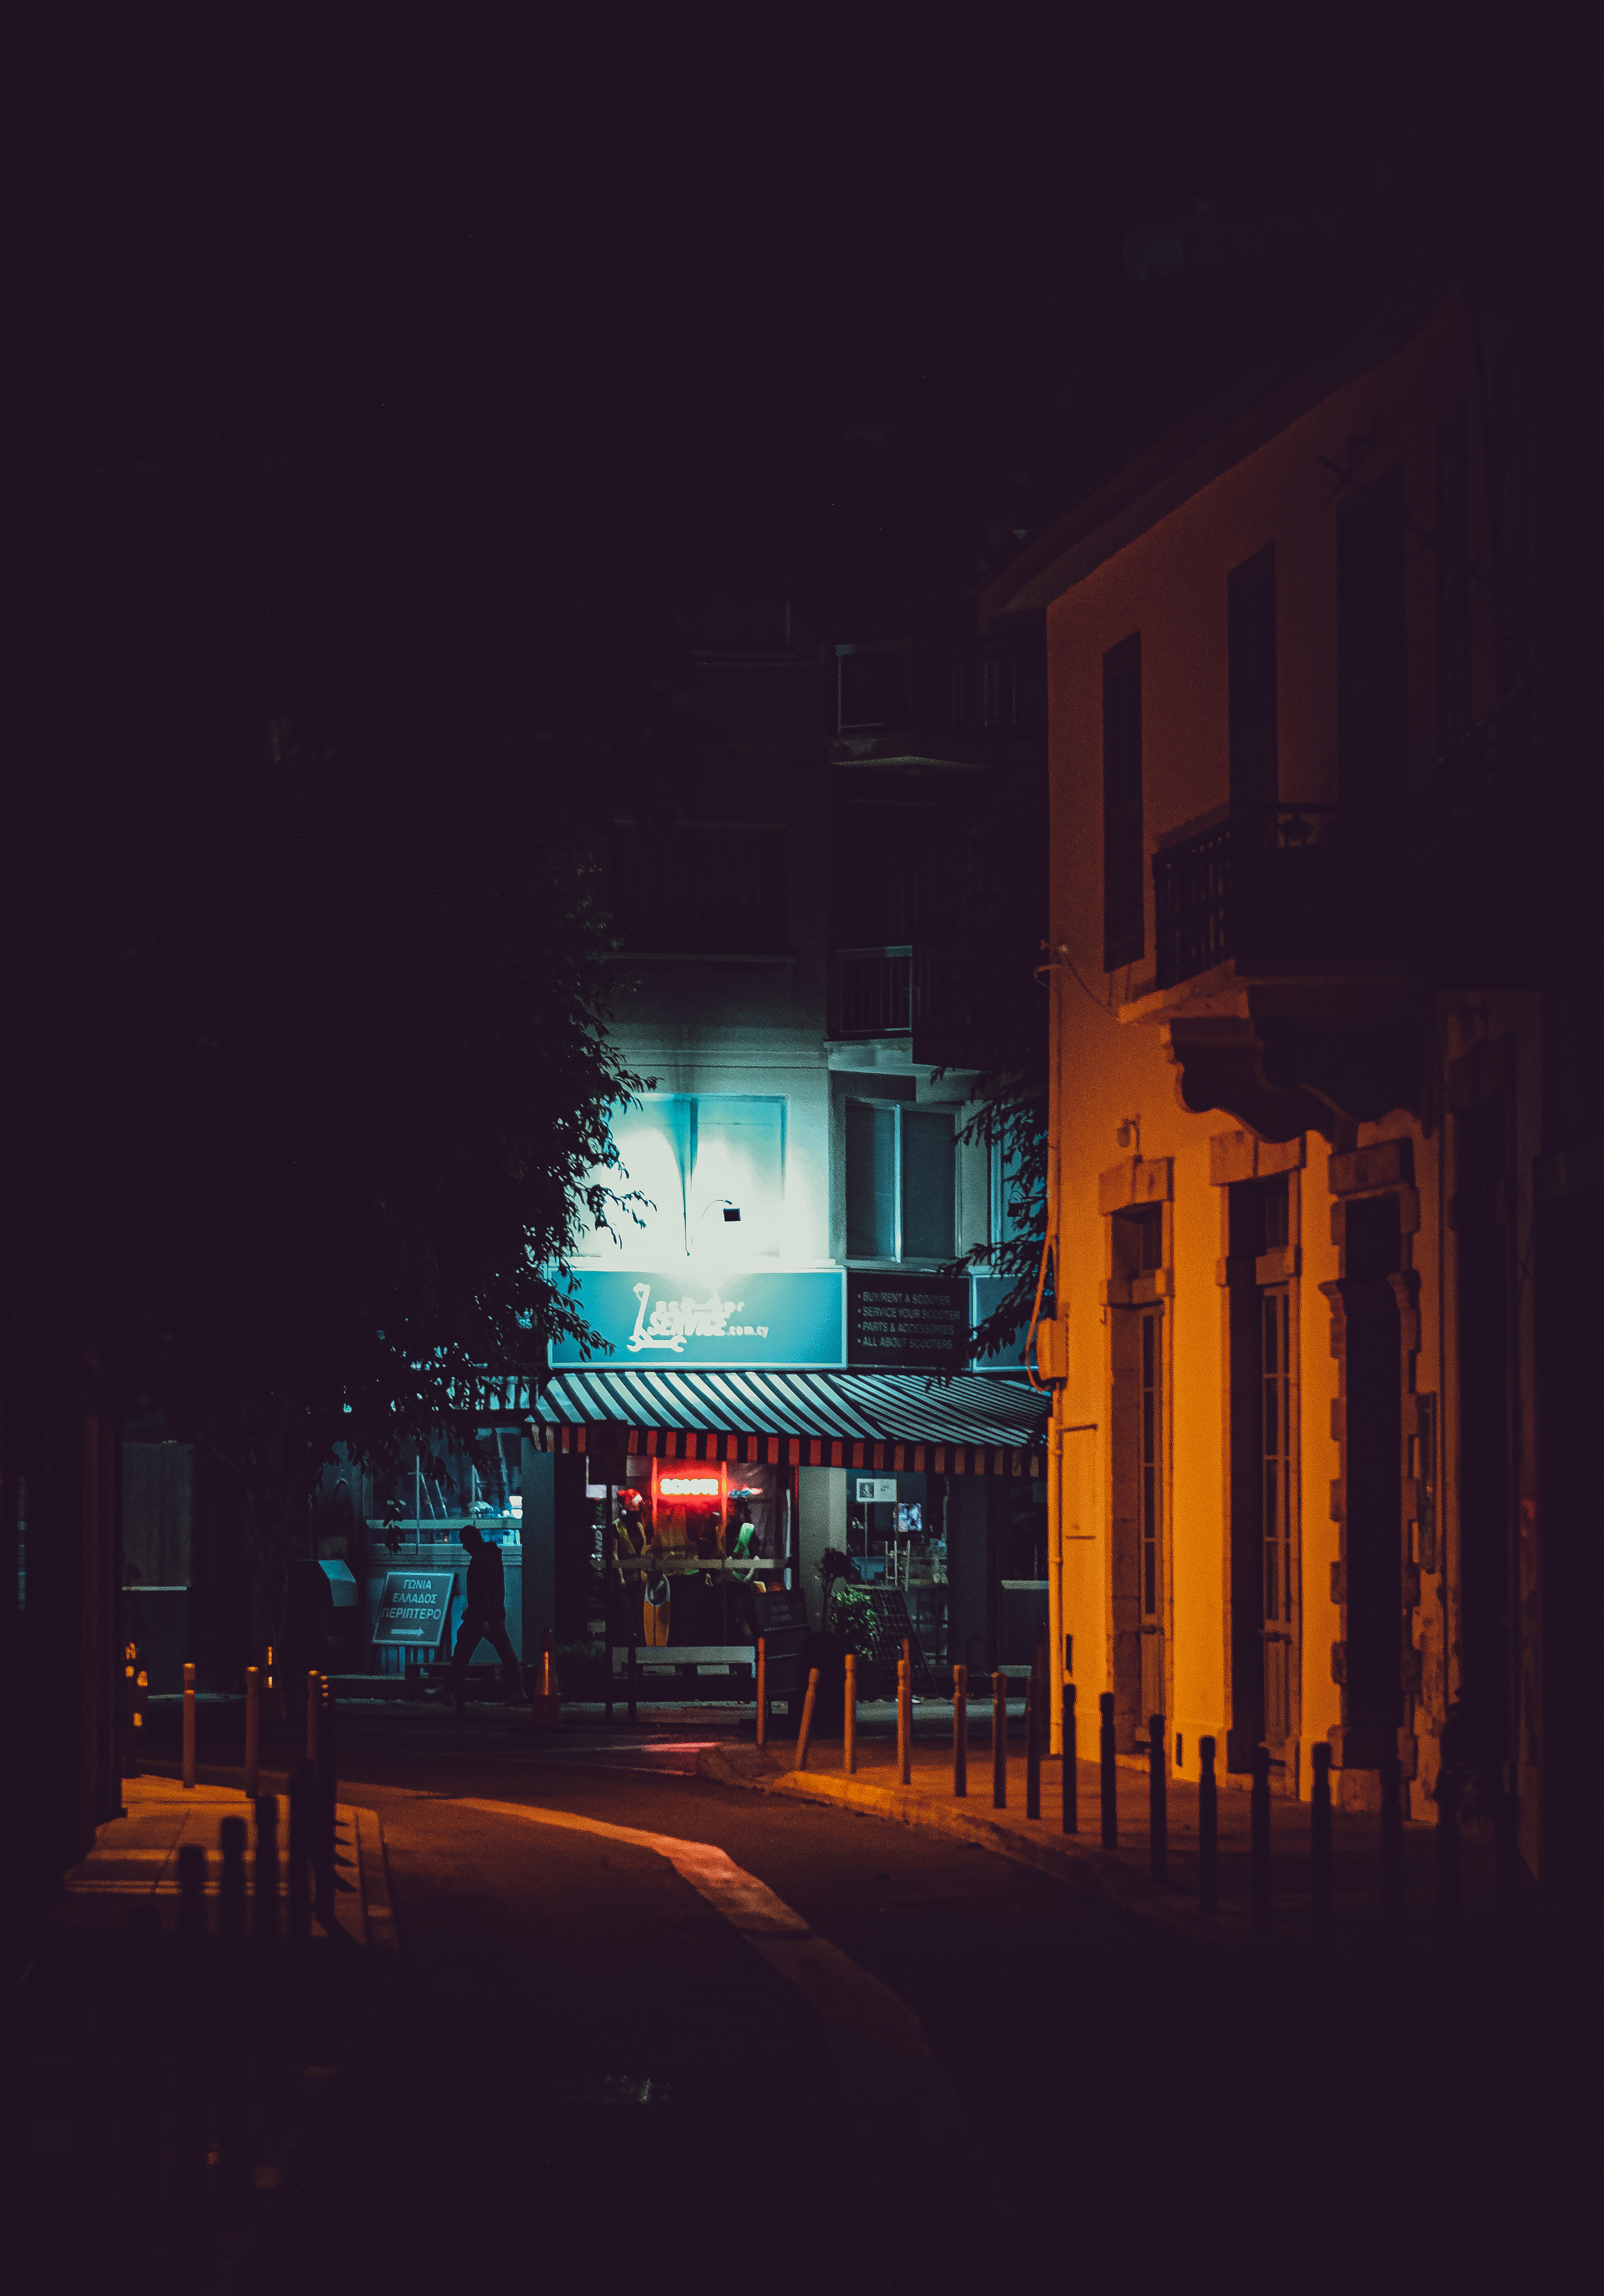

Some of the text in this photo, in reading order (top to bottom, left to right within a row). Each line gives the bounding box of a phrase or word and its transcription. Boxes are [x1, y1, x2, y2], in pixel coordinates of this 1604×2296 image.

[905, 1294, 910, 1303] A
[912, 1294, 951, 1306] SCOOTER
[862, 1306, 961, 1321] SERVICE YOUR SCOOTER
[862, 1321, 955, 1335] PARTS & ACCESSORIES
[862, 1336, 953, 1349] ALL ABOUT SCOOTERS
[403, 1579, 432, 1590] ΓΩΝΙΑ
[392, 1592, 438, 1604] ΕΛΛΑΔΟΣ
[382, 1607, 442, 1620] ΠΕΡΙΠΤΕΡΟ
